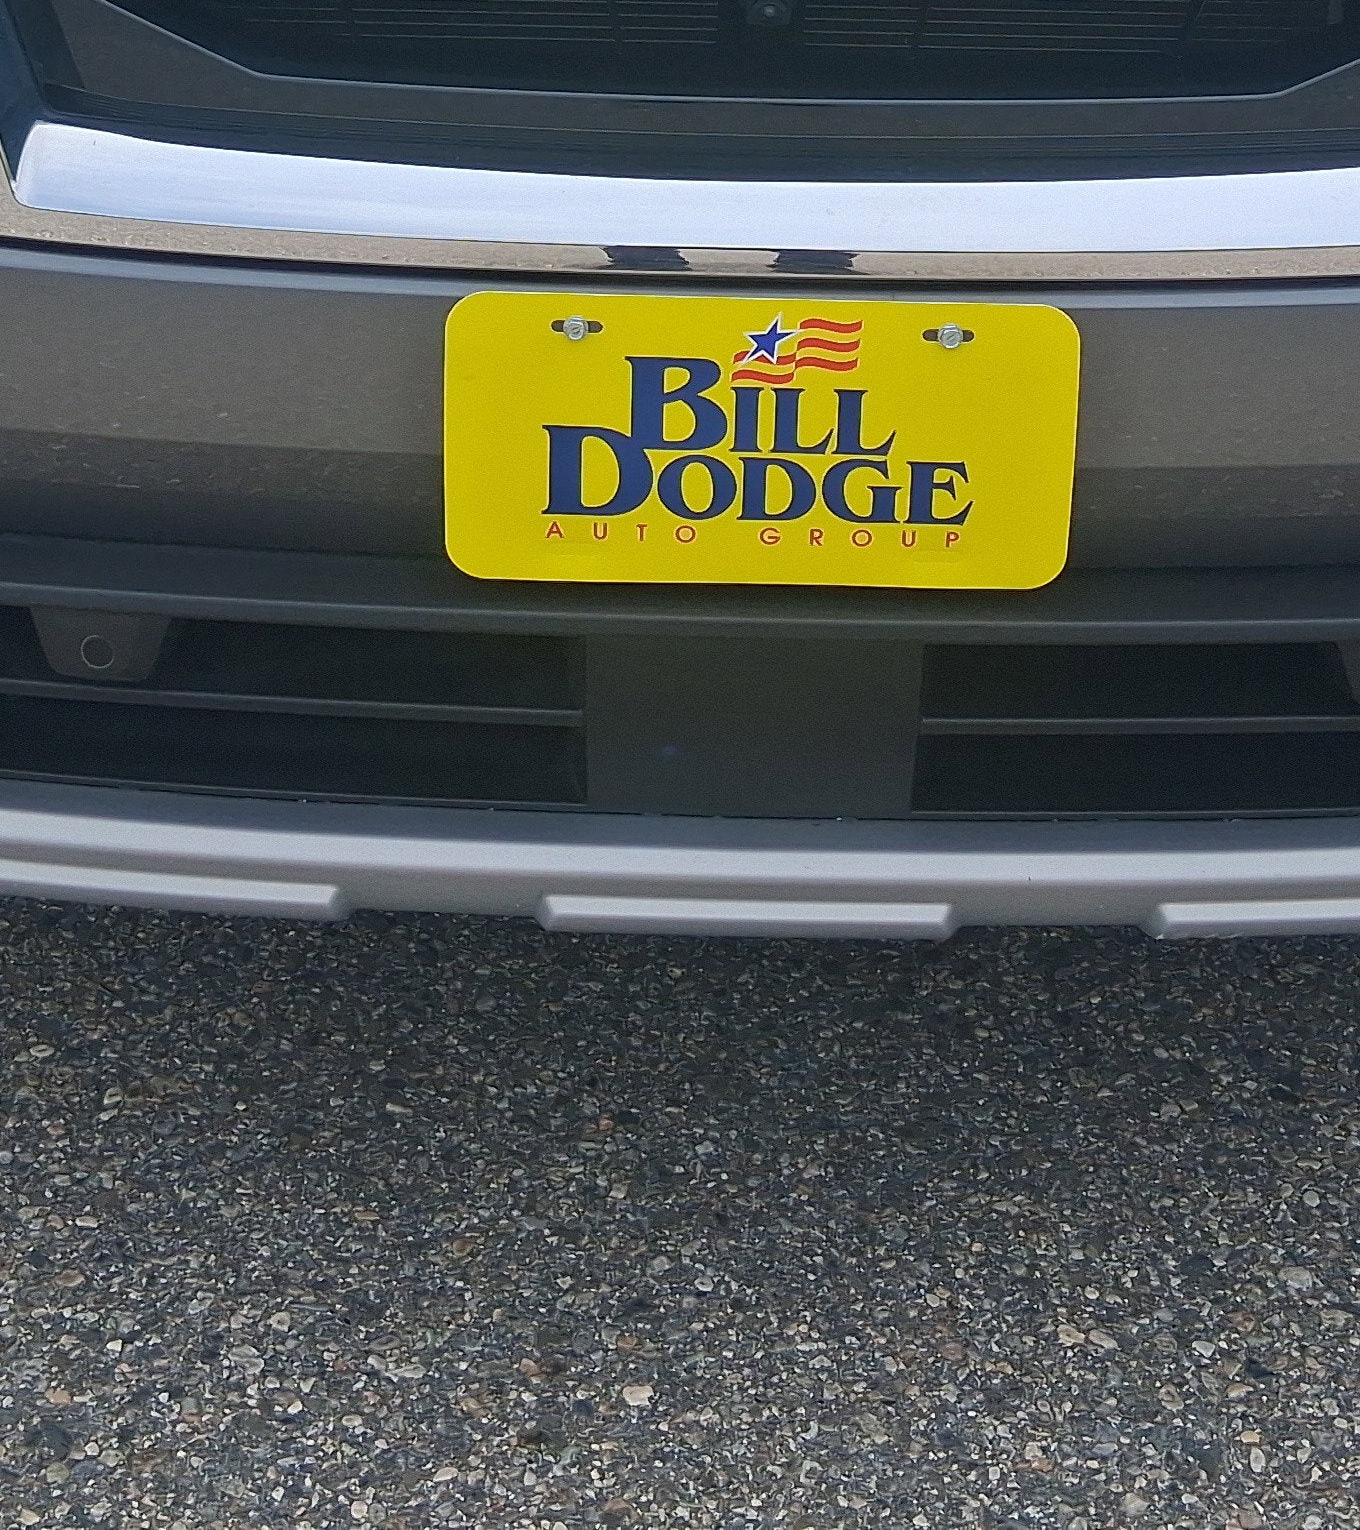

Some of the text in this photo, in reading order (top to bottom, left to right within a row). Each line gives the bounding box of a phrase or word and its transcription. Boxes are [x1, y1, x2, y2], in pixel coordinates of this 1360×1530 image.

[624, 356, 896, 456] BILL
[541, 425, 975, 526] DODGE
[544, 521, 961, 548] AUTO GROUP
